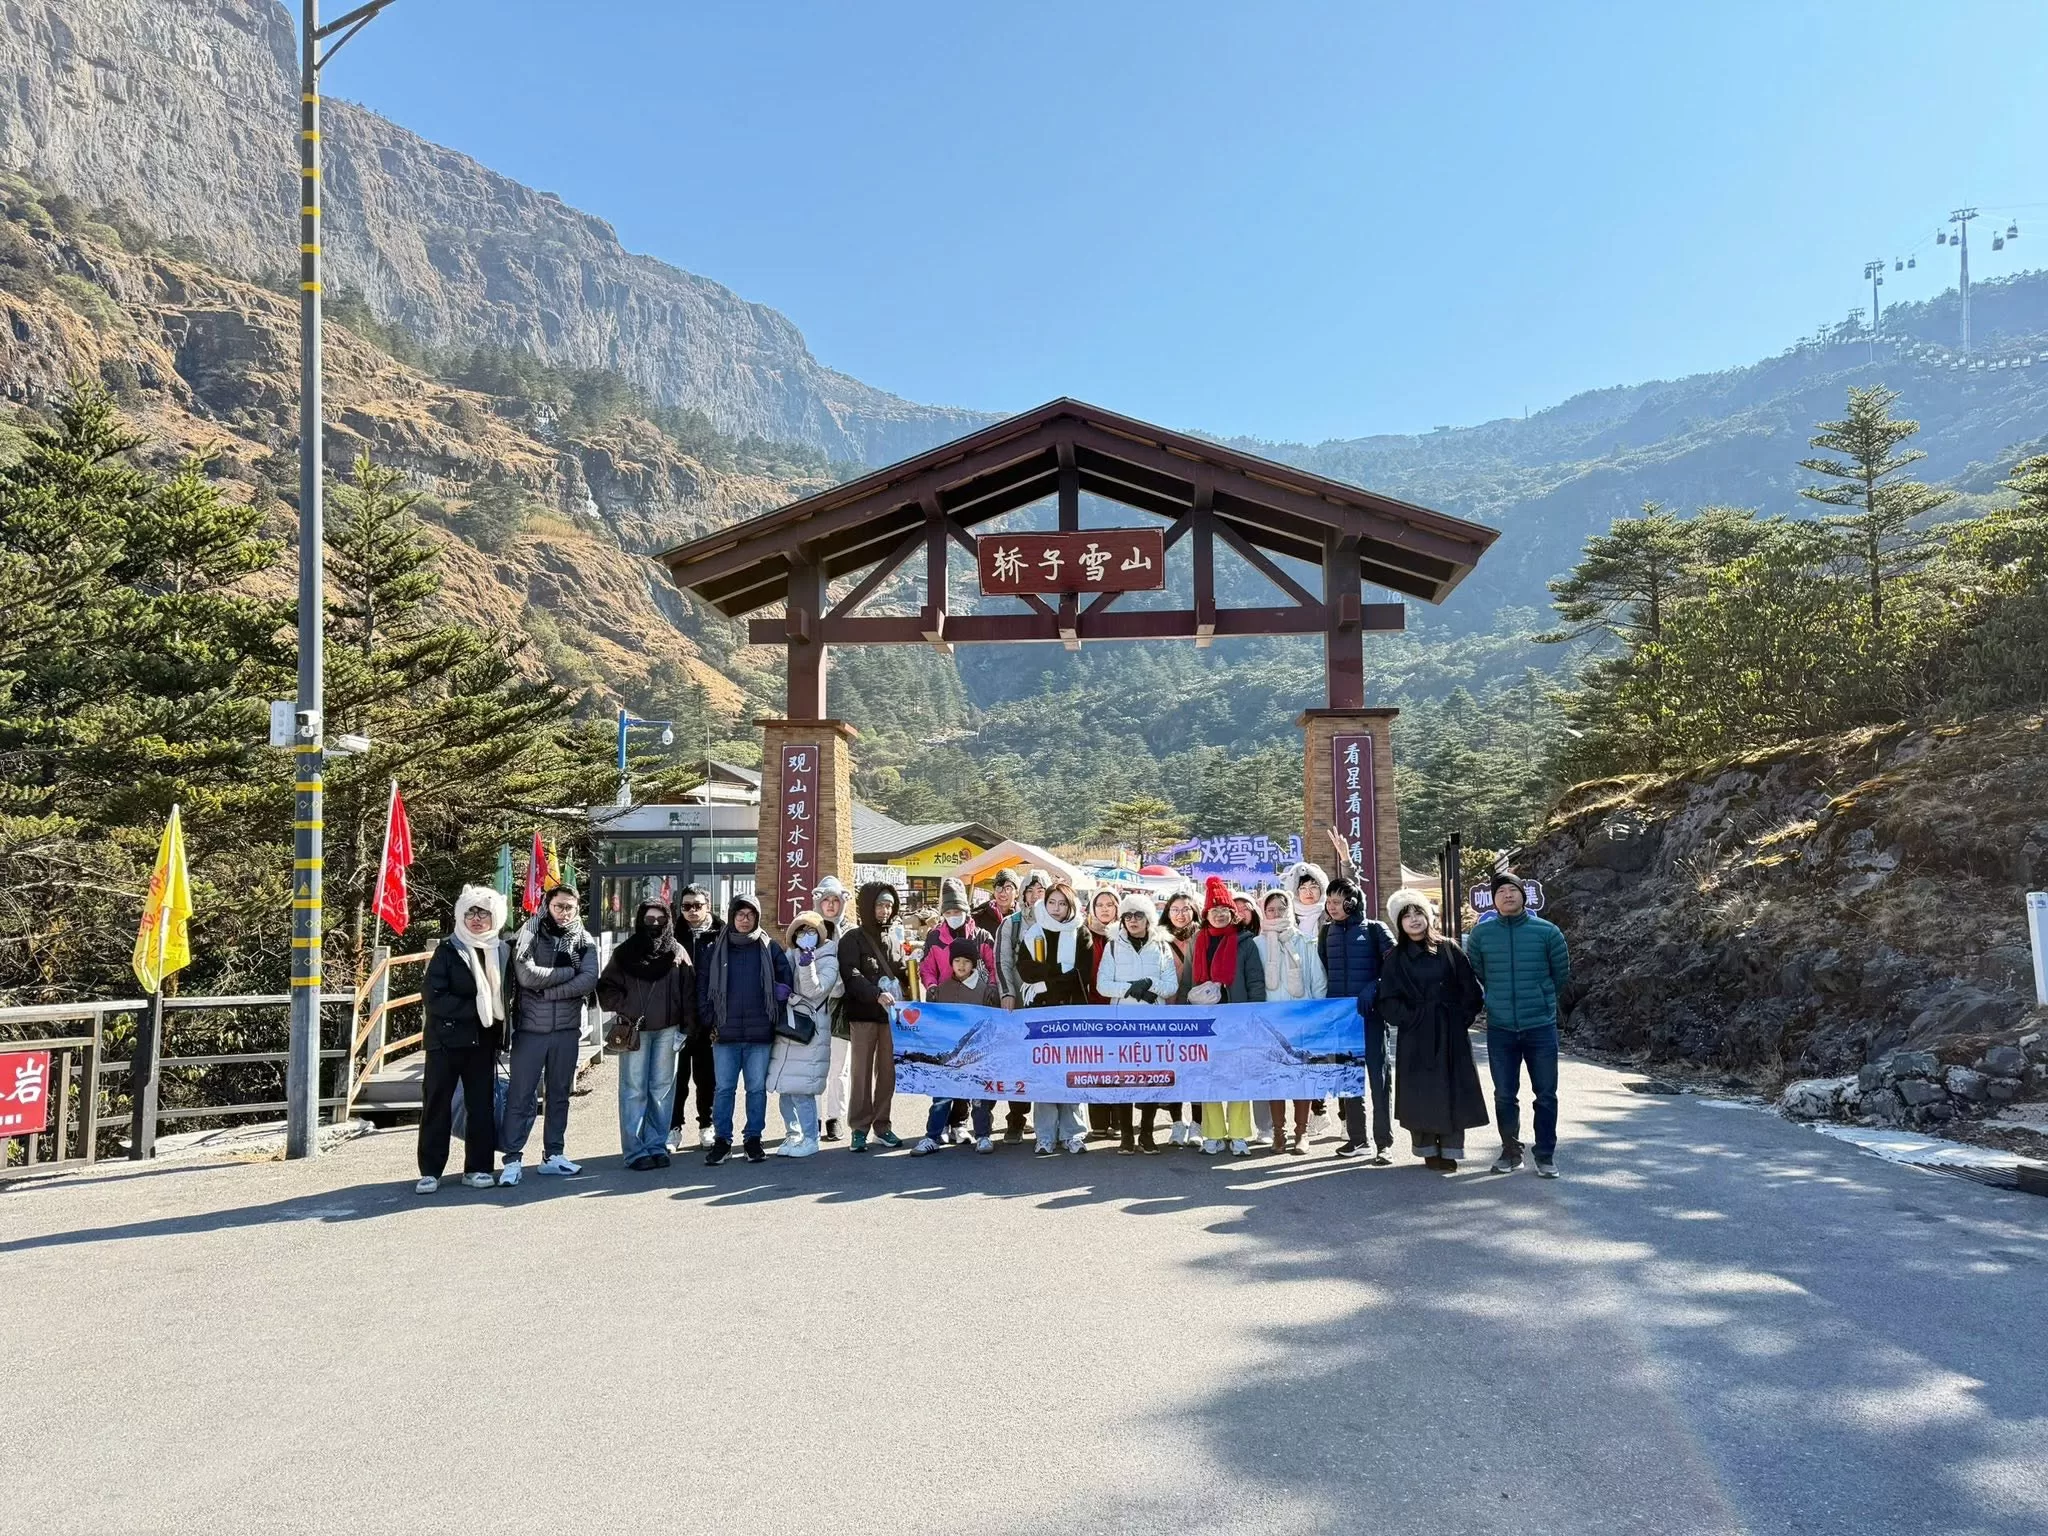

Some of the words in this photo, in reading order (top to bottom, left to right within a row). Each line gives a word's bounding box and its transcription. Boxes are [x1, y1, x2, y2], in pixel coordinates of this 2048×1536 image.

[992, 542, 1152, 584] 轿子雪山
[786, 753, 811, 918] 观山观水观天下
[1041, 1021, 1070, 1033] CHÀO
[1072, 1020, 1103, 1032] MỪNG
[1106, 1020, 1136, 1032] ĐOÀN
[1139, 1022, 1166, 1032] THAM
[1169, 1022, 1199, 1032] QUAN
[1032, 1043, 1061, 1064] CÔN
[1065, 1045, 1104, 1064] MINH
[1119, 1041, 1151, 1067] KIỆU
[1155, 1039, 1175, 1063] TỬ
[1179, 1044, 1208, 1063] SƠN
[984, 1080, 1005, 1093] XE
[1015, 1080, 1026, 1094] 2
